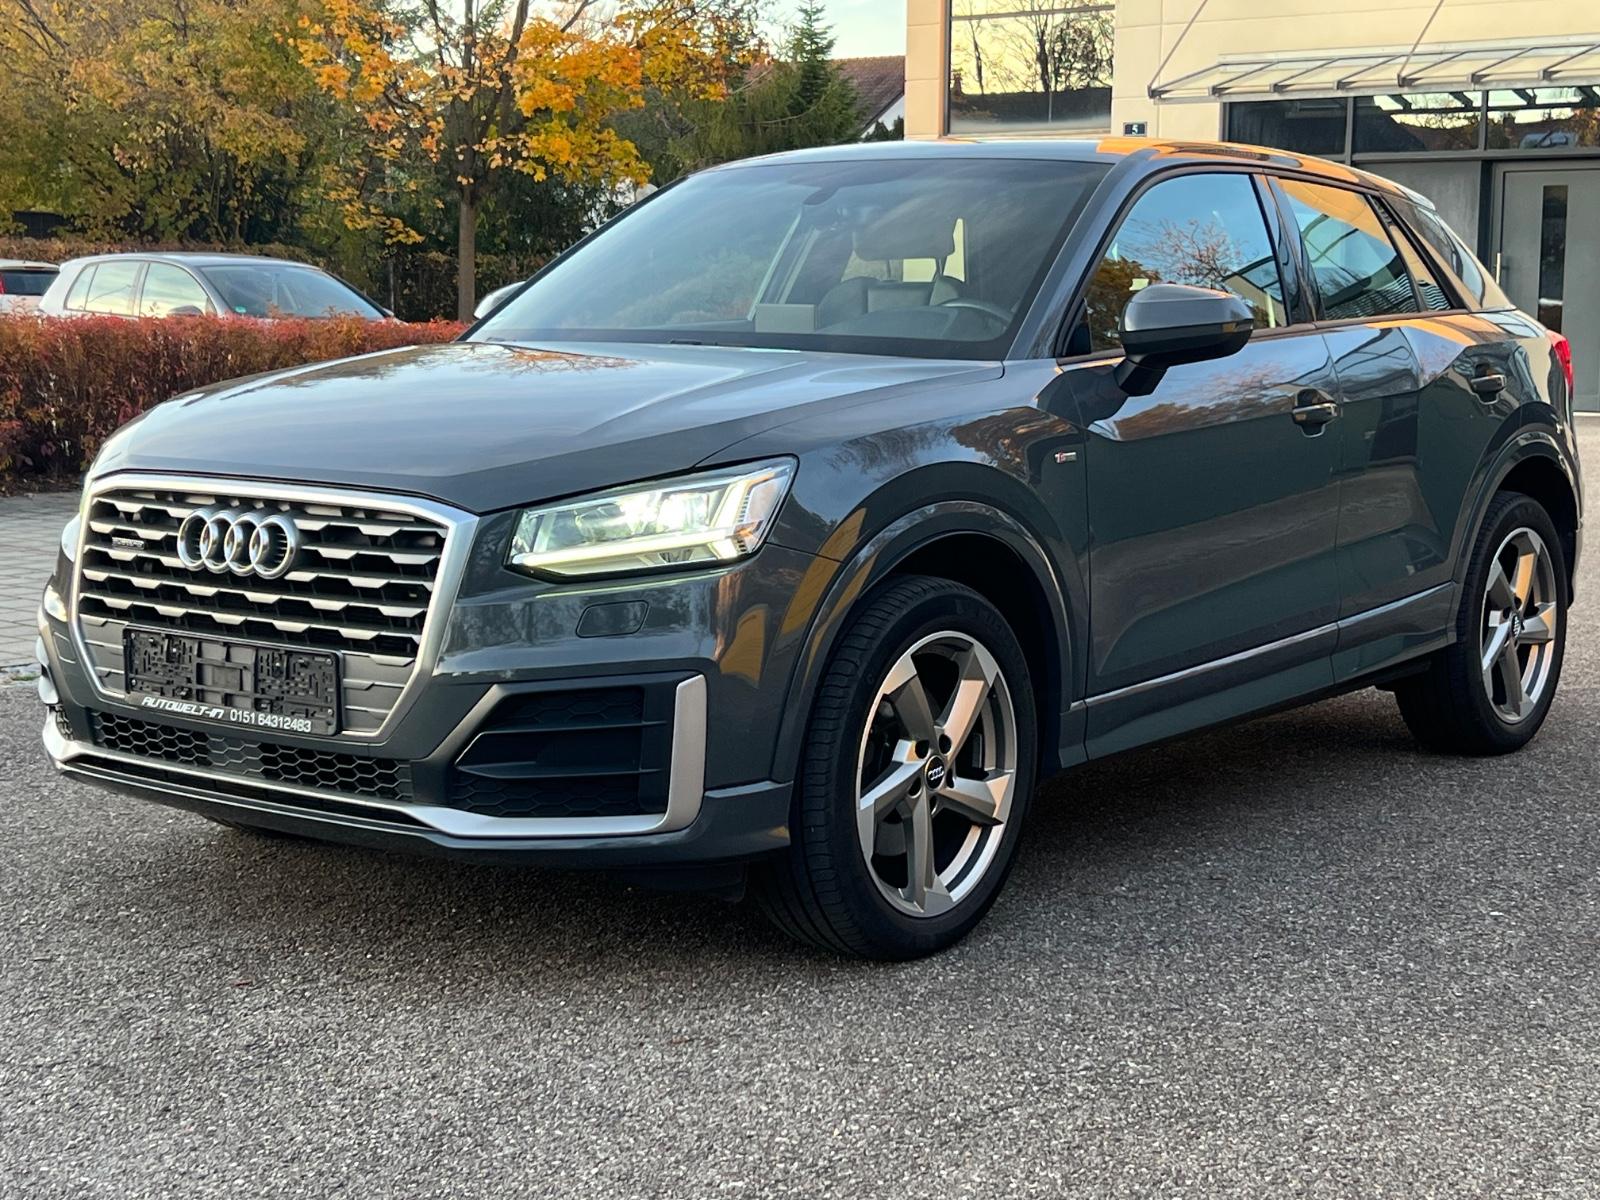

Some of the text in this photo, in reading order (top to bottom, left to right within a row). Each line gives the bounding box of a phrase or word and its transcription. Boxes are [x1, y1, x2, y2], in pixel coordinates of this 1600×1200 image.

[1131, 124, 1139, 135] 5
[229, 708, 255, 724] 0151
[257, 713, 312, 733] 64312483
